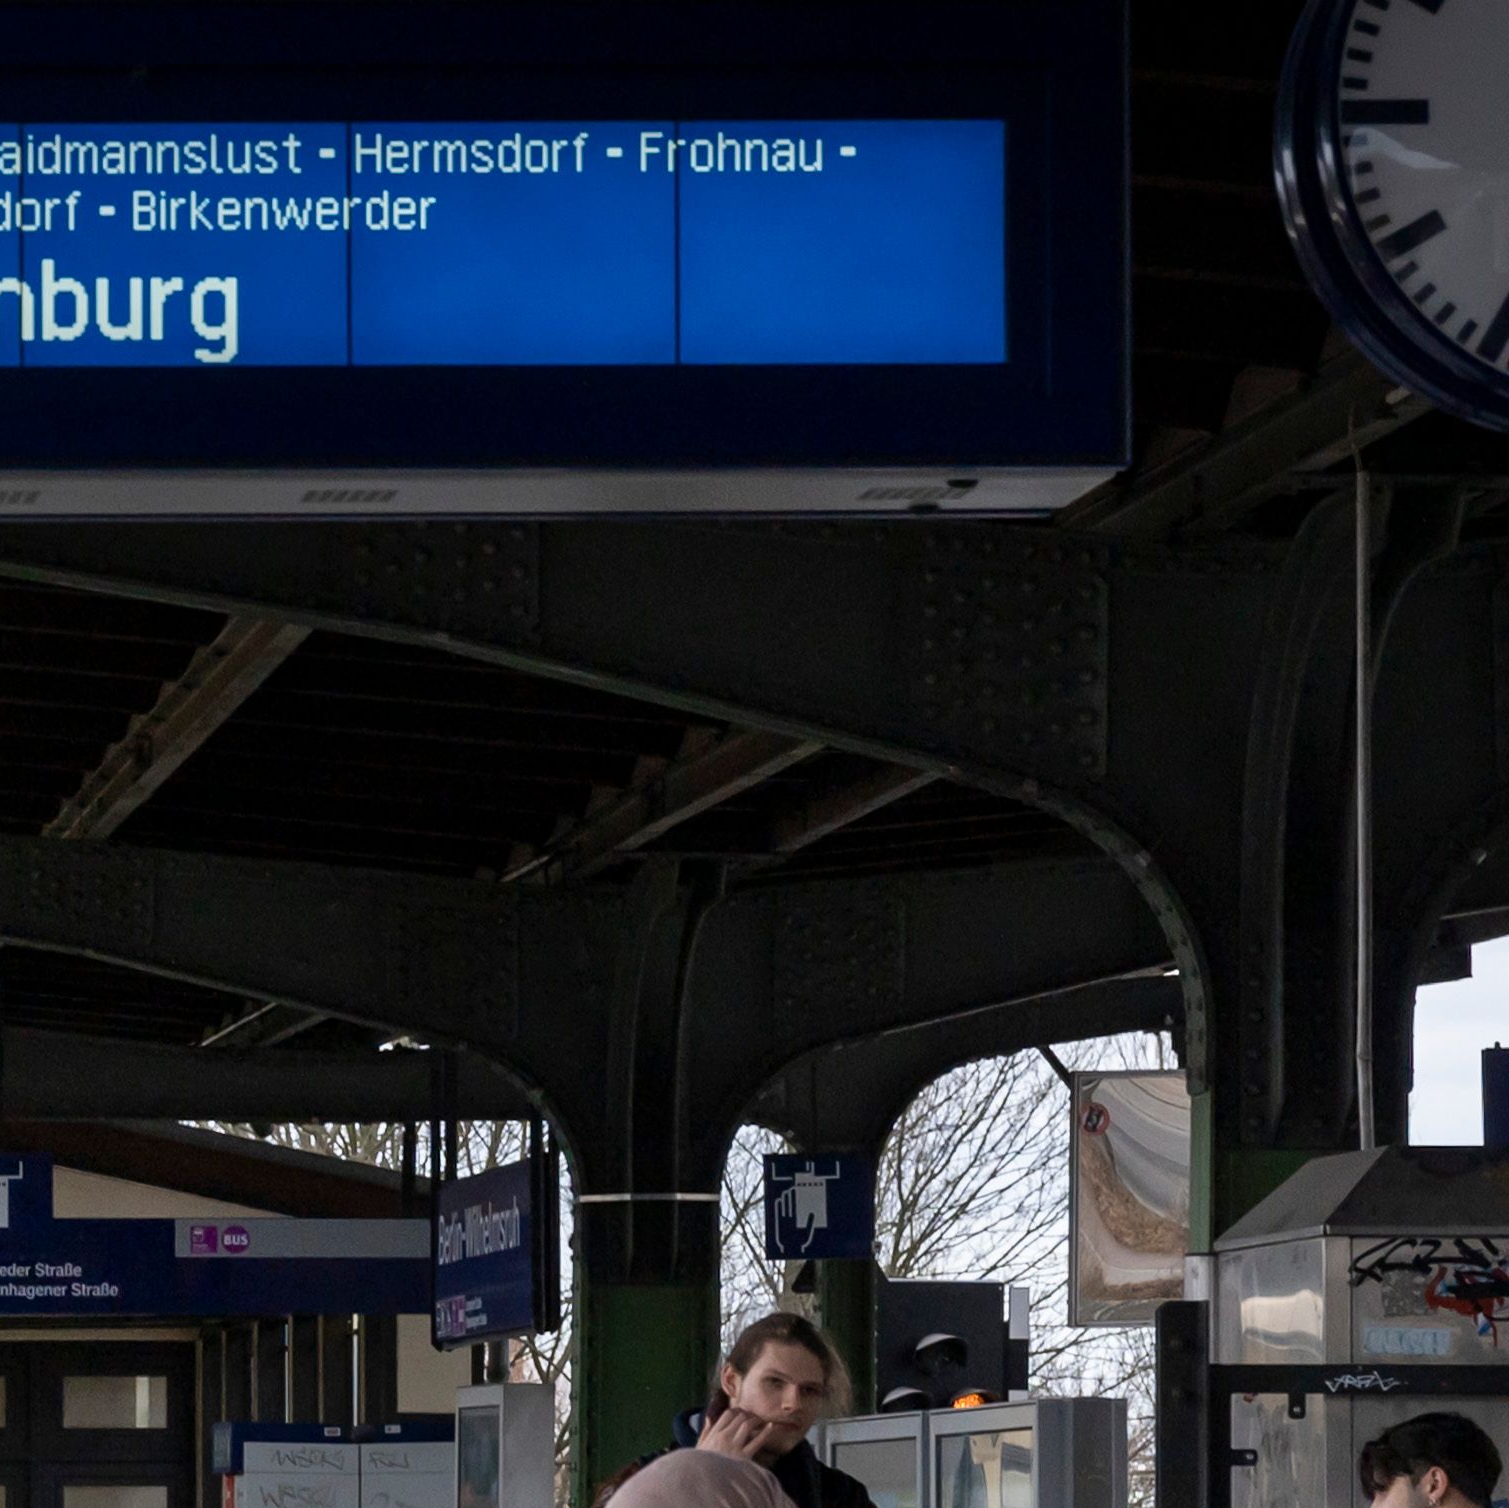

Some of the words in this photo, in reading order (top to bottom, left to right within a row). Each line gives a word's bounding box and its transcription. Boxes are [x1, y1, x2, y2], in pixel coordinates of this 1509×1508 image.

[355, 132, 588, 174] Hermsdorf
[640, 132, 823, 173] Frohnau
[132, 189, 436, 232] Birkenwerder
[223, 1234, 249, 1246] BUS
[34, 1262, 82, 1277] Straße
